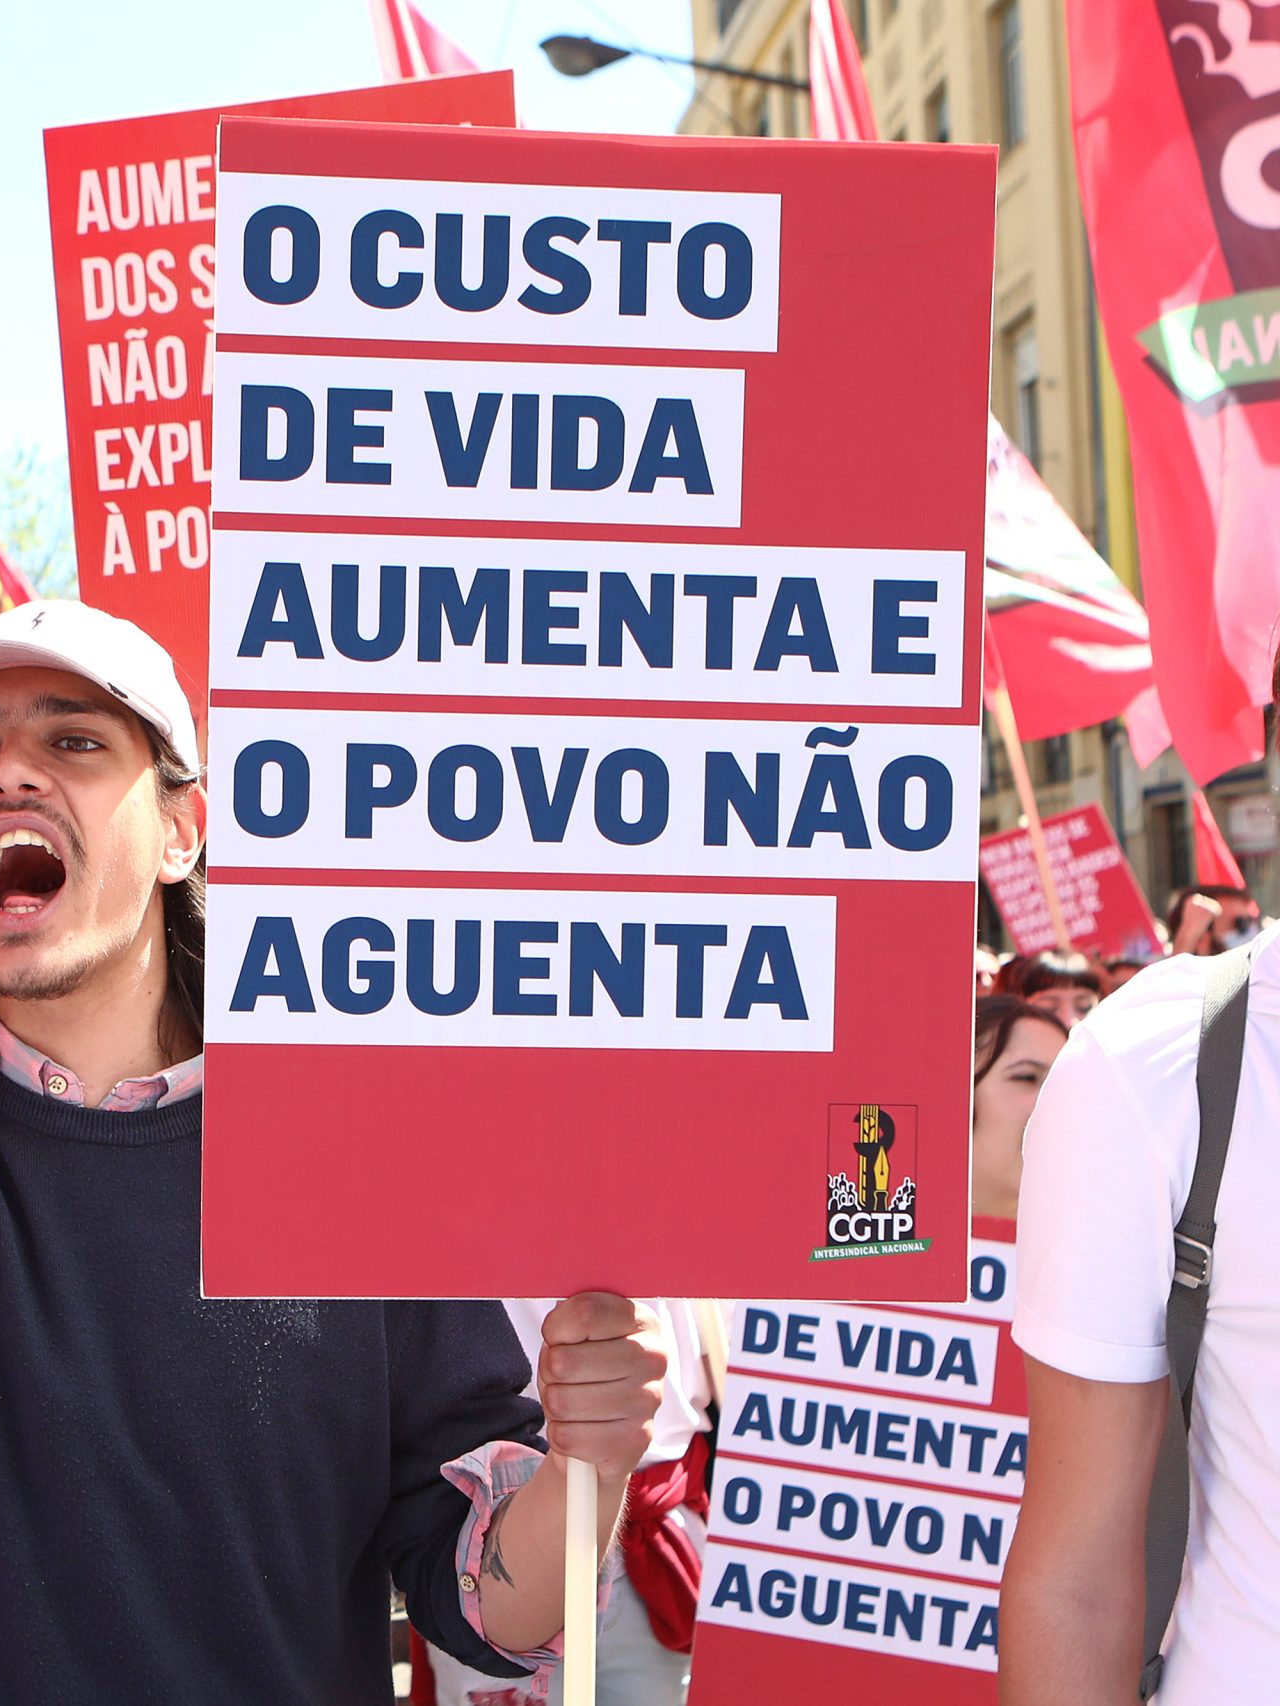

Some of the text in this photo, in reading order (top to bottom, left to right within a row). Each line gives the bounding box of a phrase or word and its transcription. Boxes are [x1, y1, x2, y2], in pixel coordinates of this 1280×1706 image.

[76, 154, 215, 235] AUME
[81, 249, 178, 321] DOS
[243, 205, 753, 320] O CUSTO
[87, 327, 188, 407] NÃO
[240, 385, 714, 494] DE VIDA
[102, 502, 211, 577] À PO
[237, 562, 937, 674] AUMENTA E
[233, 740, 310, 838] O
[345, 743, 670, 845] POVO
[704, 726, 953, 851] NÃO
[228, 917, 809, 1020] AGUENTA
[814, 1242, 925, 1259] INTERSINDICAL NACIONAL
[829, 1212, 913, 1243] CGTP
[970, 1256, 1006, 1302] O
[741, 1308, 978, 1386] DE VIDA
[732, 1392, 1029, 1480] AUMENTA
[723, 1476, 1003, 1566] O POVO N
[710, 1562, 999, 1654] AGUENTA
